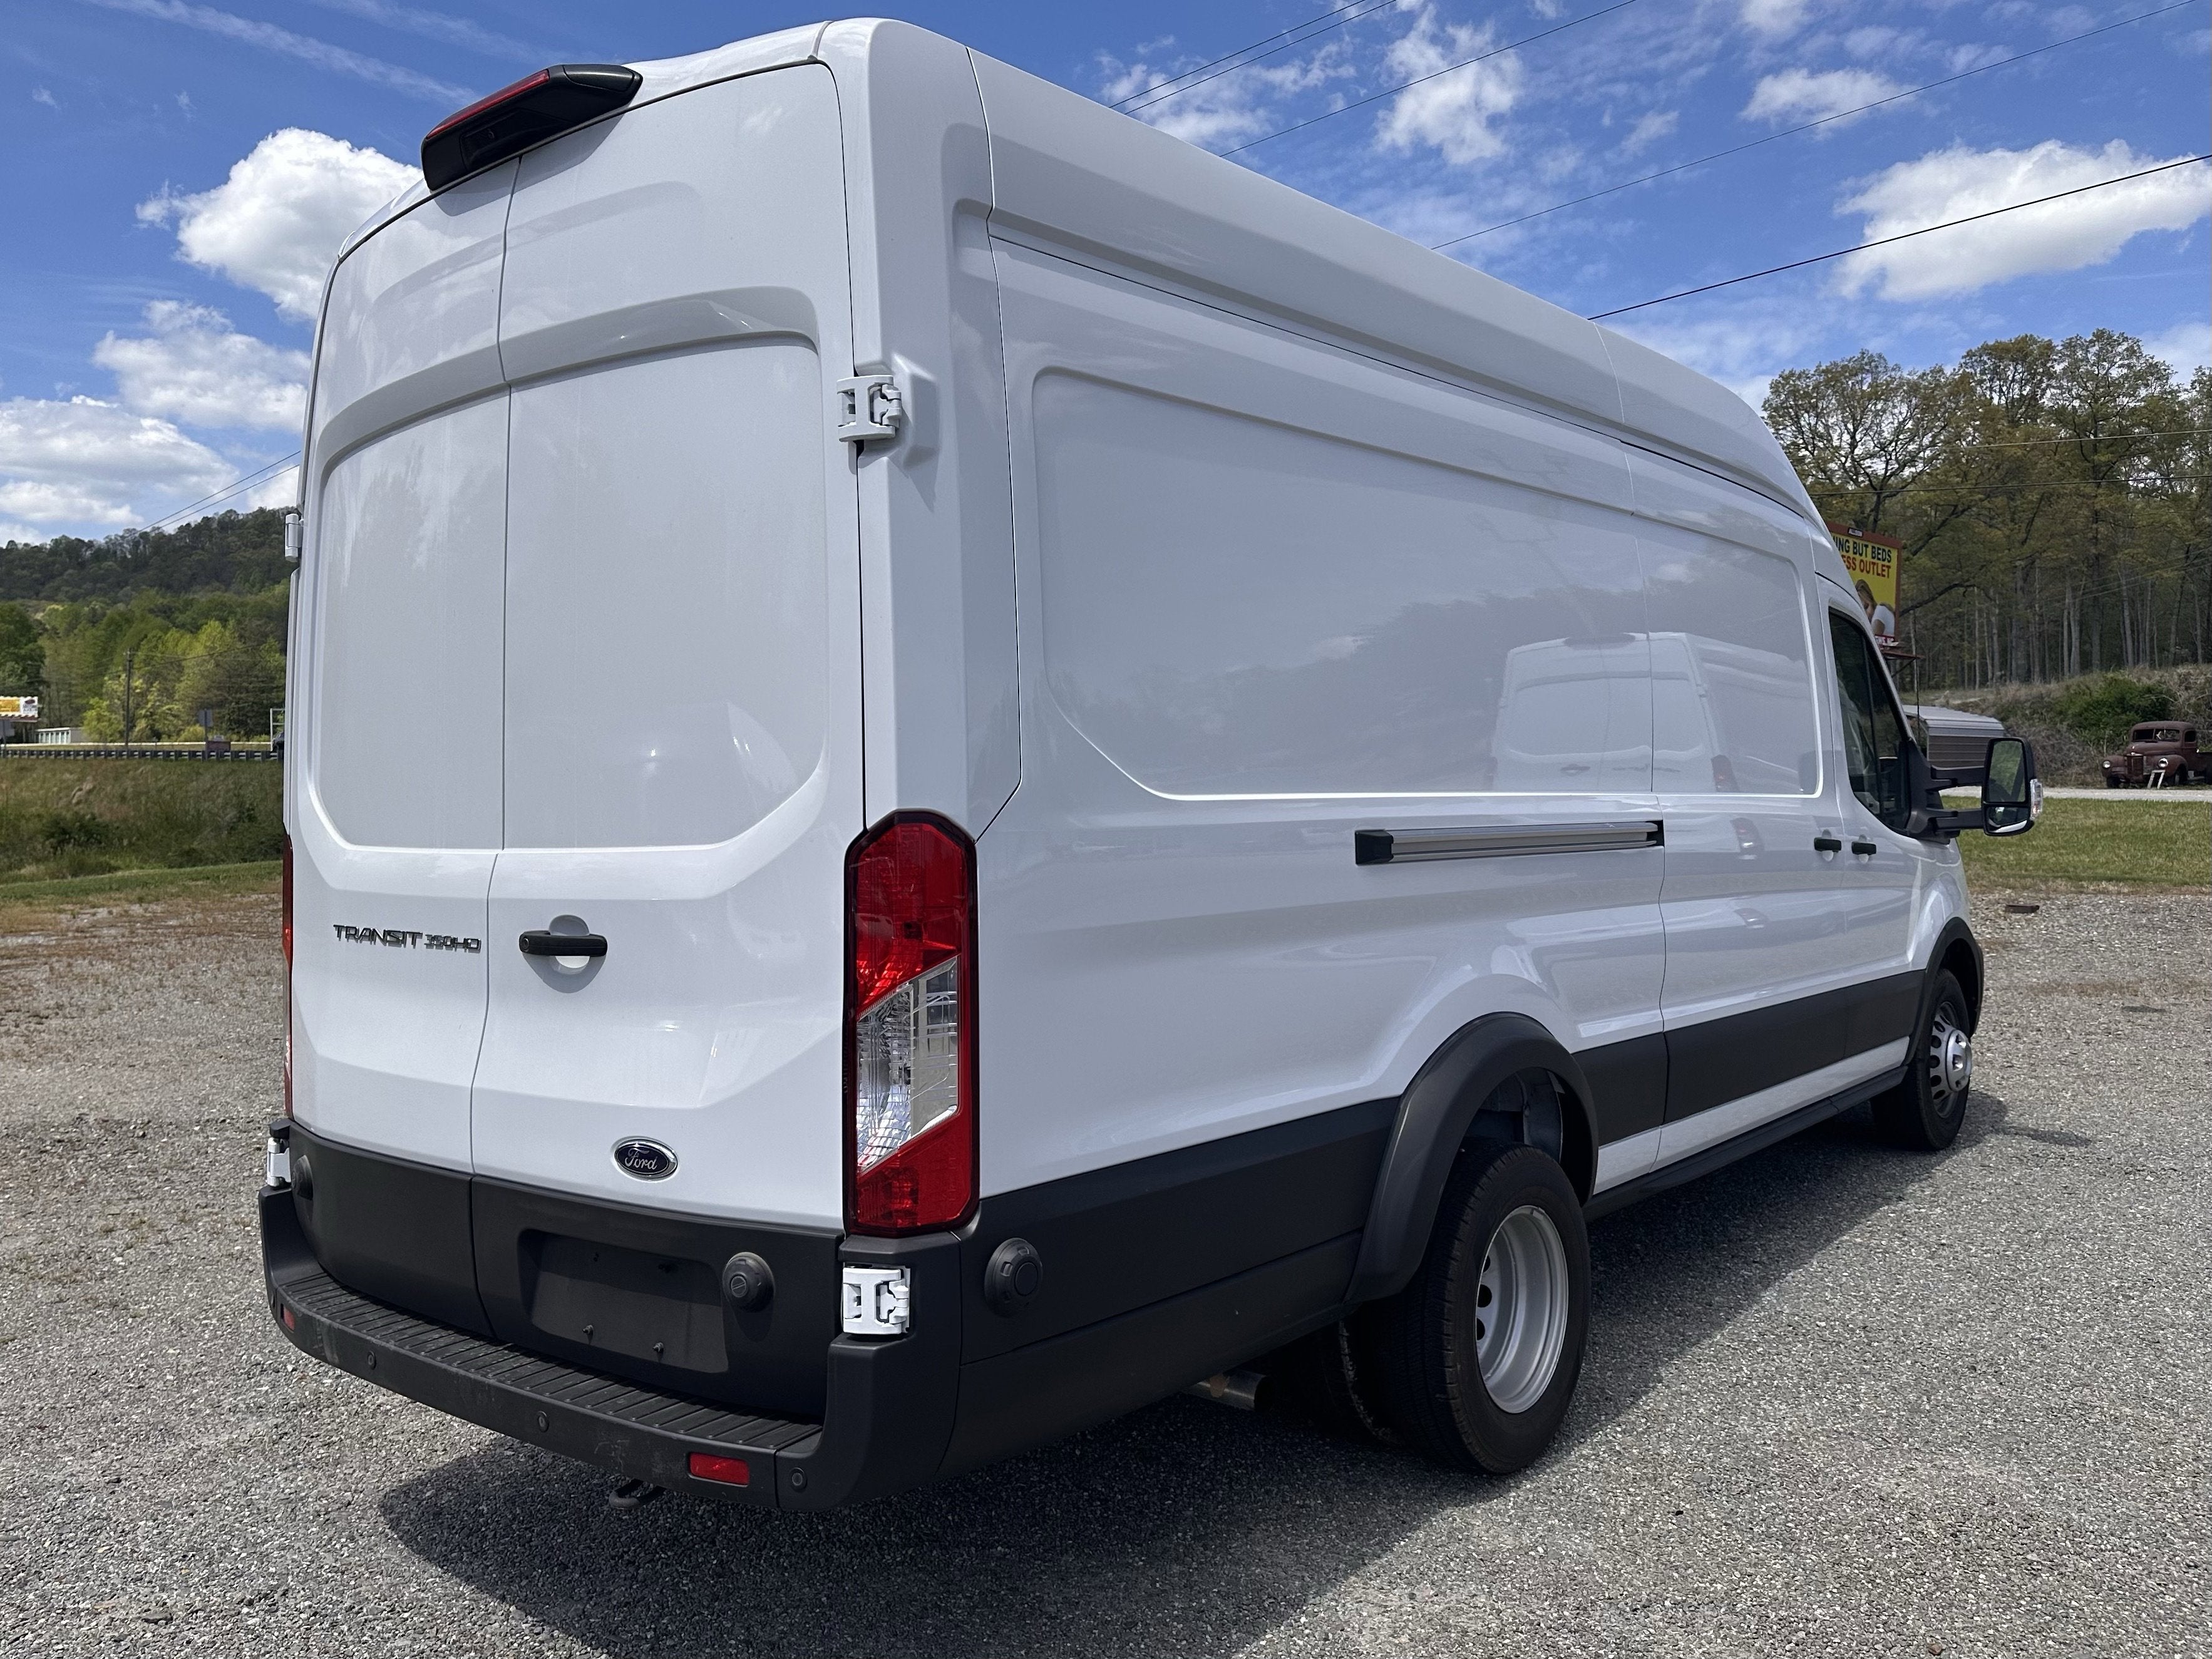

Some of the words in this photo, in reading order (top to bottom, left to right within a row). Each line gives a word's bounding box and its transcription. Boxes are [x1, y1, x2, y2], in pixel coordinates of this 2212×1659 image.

[1833, 536, 1850, 553] ING
[1853, 539, 1868, 558] BUT
[1871, 545, 1891, 563] BEDS
[1859, 559, 1891, 578] OUTLET
[333, 924, 423, 948] TRANSIT
[624, 1148, 658, 1169] Ford
